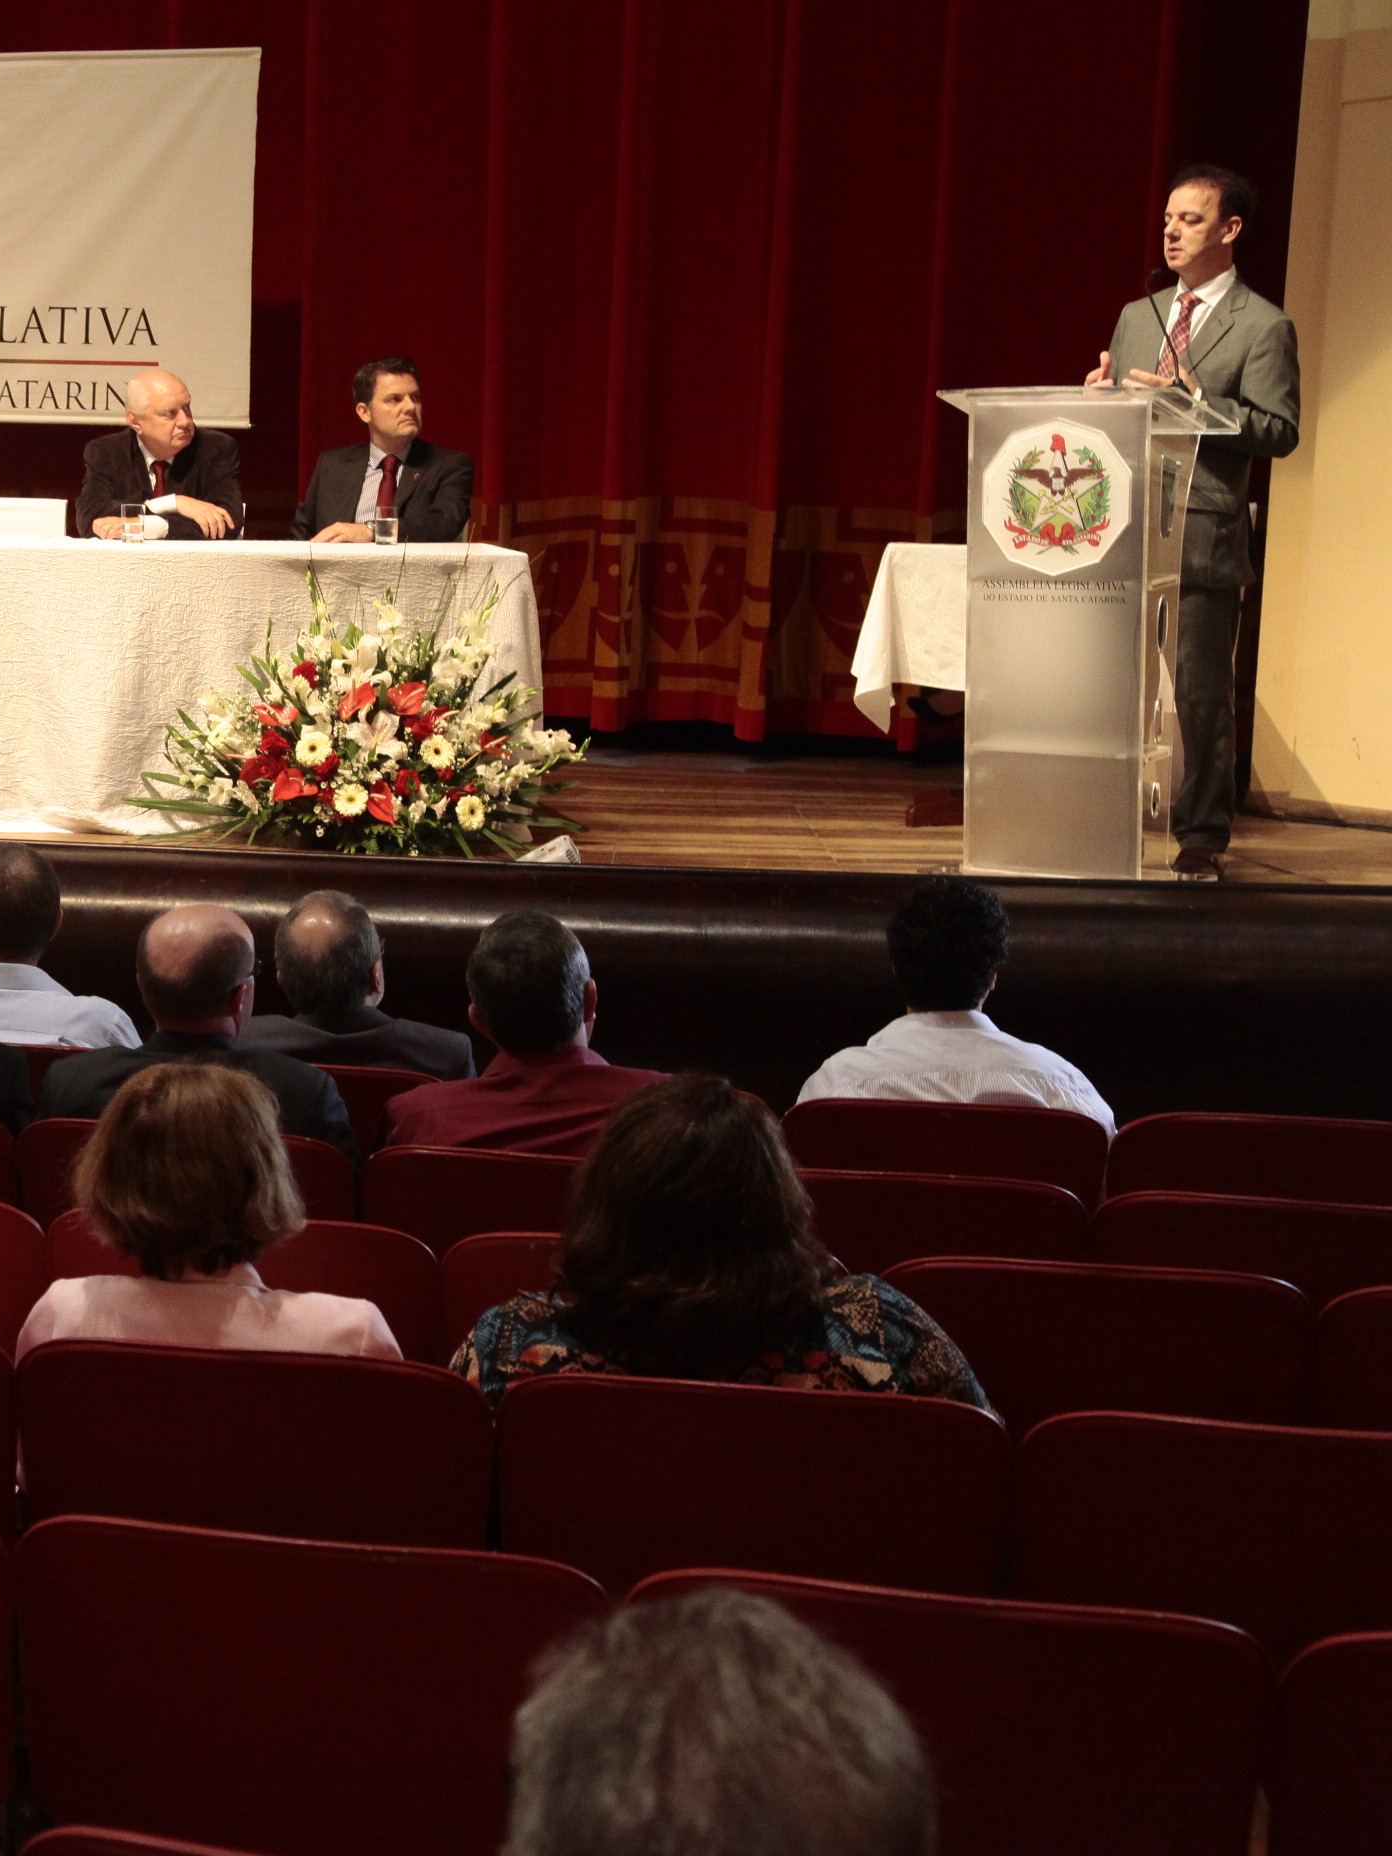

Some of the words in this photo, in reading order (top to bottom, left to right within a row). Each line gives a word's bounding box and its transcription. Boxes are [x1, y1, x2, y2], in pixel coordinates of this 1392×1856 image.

[1014, 535, 1041, 545] ESTADO
[1074, 534, 1101, 543] CATARINA
[982, 579, 1051, 590] ASSEMBLEIA
[1054, 581, 1126, 591] LEGISLATIVA
[998, 594, 1033, 602] ESTADO
[1051, 595, 1078, 603] SANTA
[1081, 596, 1126, 604] CATARINA
